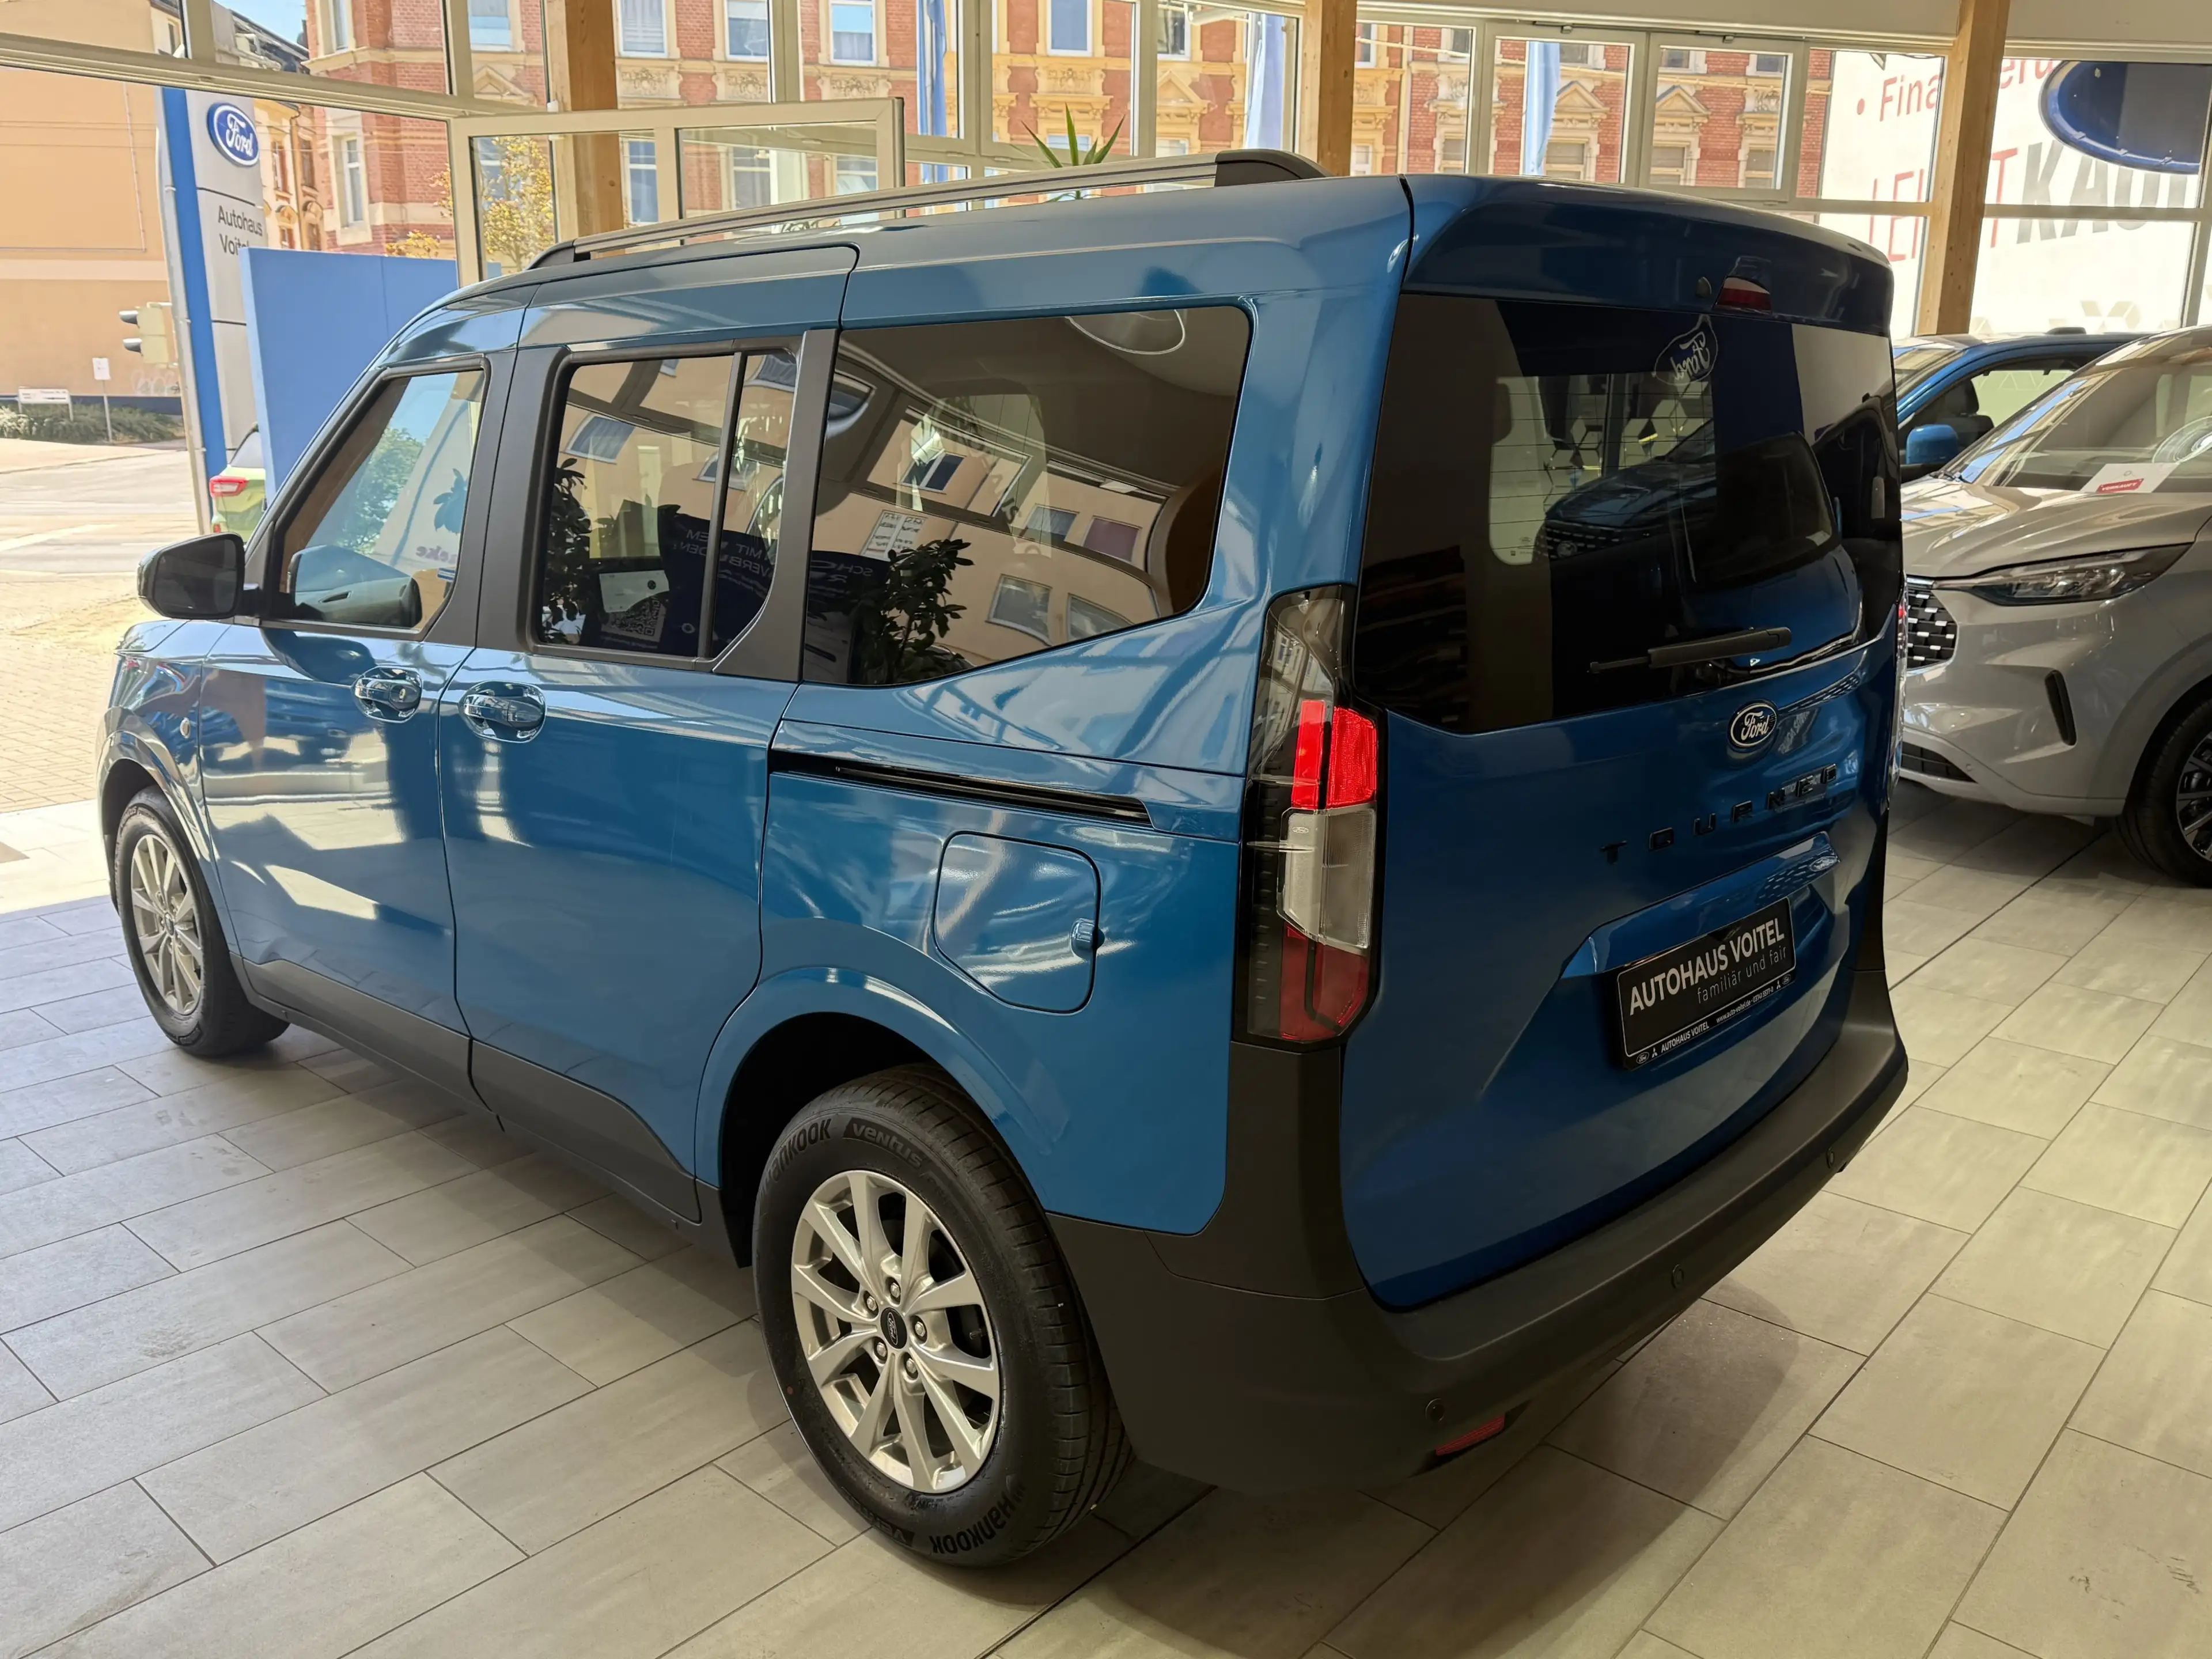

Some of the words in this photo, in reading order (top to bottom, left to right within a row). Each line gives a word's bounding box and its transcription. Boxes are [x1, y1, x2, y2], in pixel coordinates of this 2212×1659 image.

[226, 113, 253, 157] Ford
[218, 205, 263, 237] Autohaus
[1741, 711, 1770, 740] Ford
[1600, 764, 1837, 863] TOURNEO
[1630, 944, 1728, 1016] AUTOHAUS
[1729, 918, 1785, 963] VOITEL
[1697, 970, 1741, 1004] familiär
[1746, 954, 1766, 978] und
[1769, 945, 1786, 965] fair
[1661, 1034, 1691, 1054] AUTOHAUS
[1691, 1021, 1710, 1037] VOITEL
